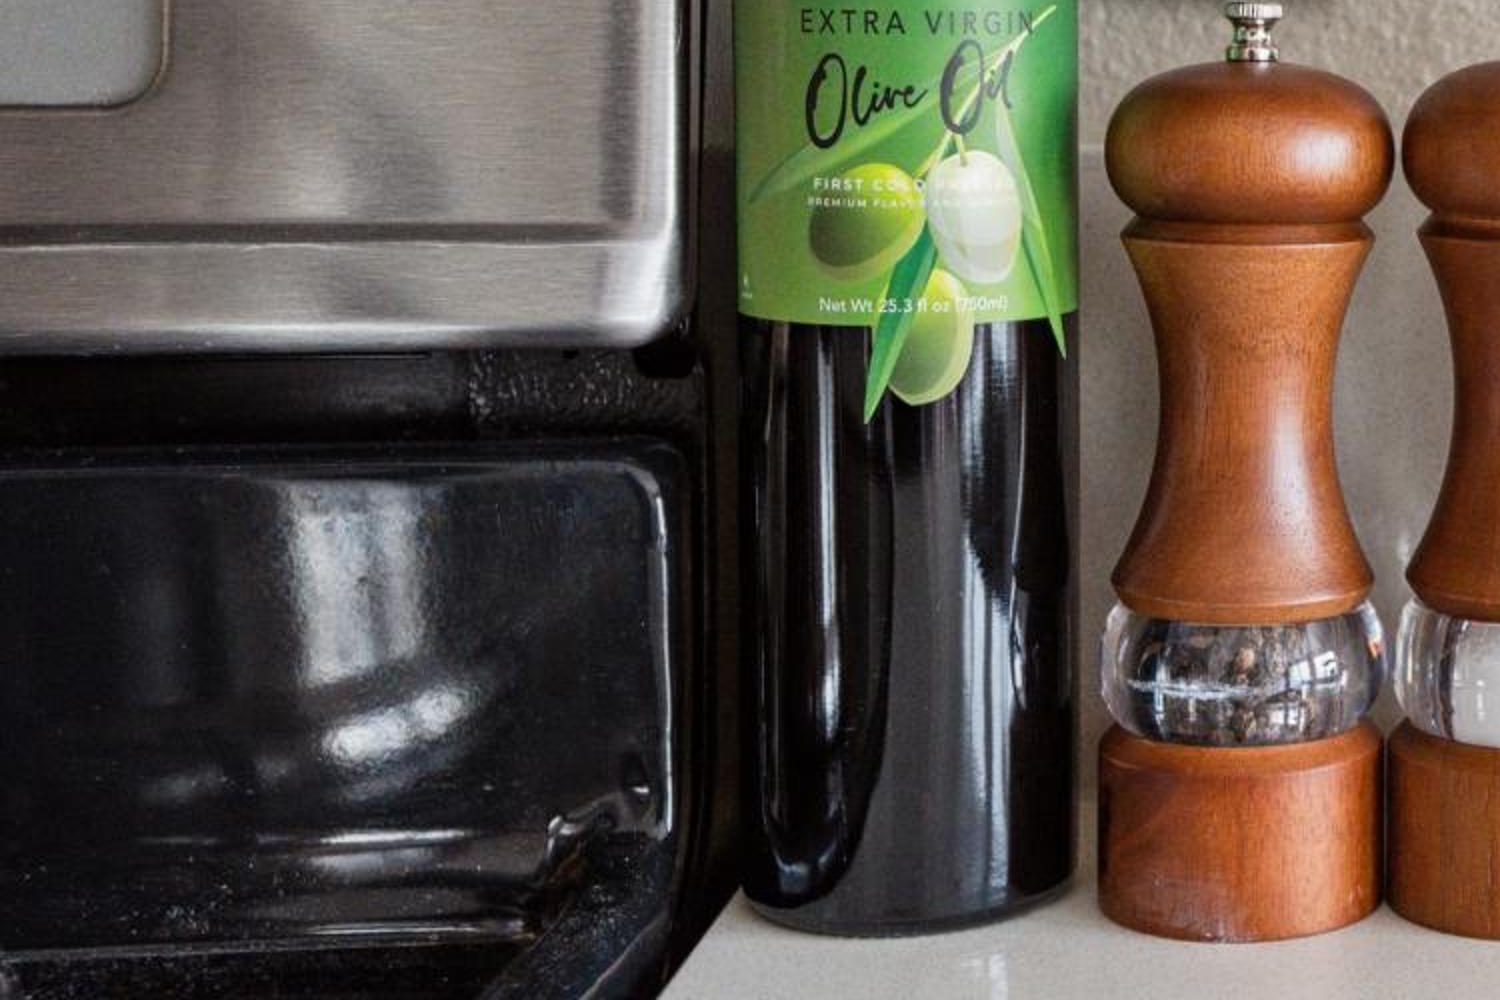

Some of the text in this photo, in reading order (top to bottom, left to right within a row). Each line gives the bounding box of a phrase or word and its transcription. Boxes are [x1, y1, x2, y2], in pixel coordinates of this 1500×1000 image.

[801, 8, 1035, 35] EXTRA VIRGIN
[805, 39, 1014, 149] Olive Oil
[813, 177, 864, 192] FIRST
[807, 197, 867, 208] PREMIUM
[818, 295, 847, 313] Net
[878, 297, 913, 313] 25.3
[917, 296, 928, 313] fl
[931, 299, 949, 313] oz
